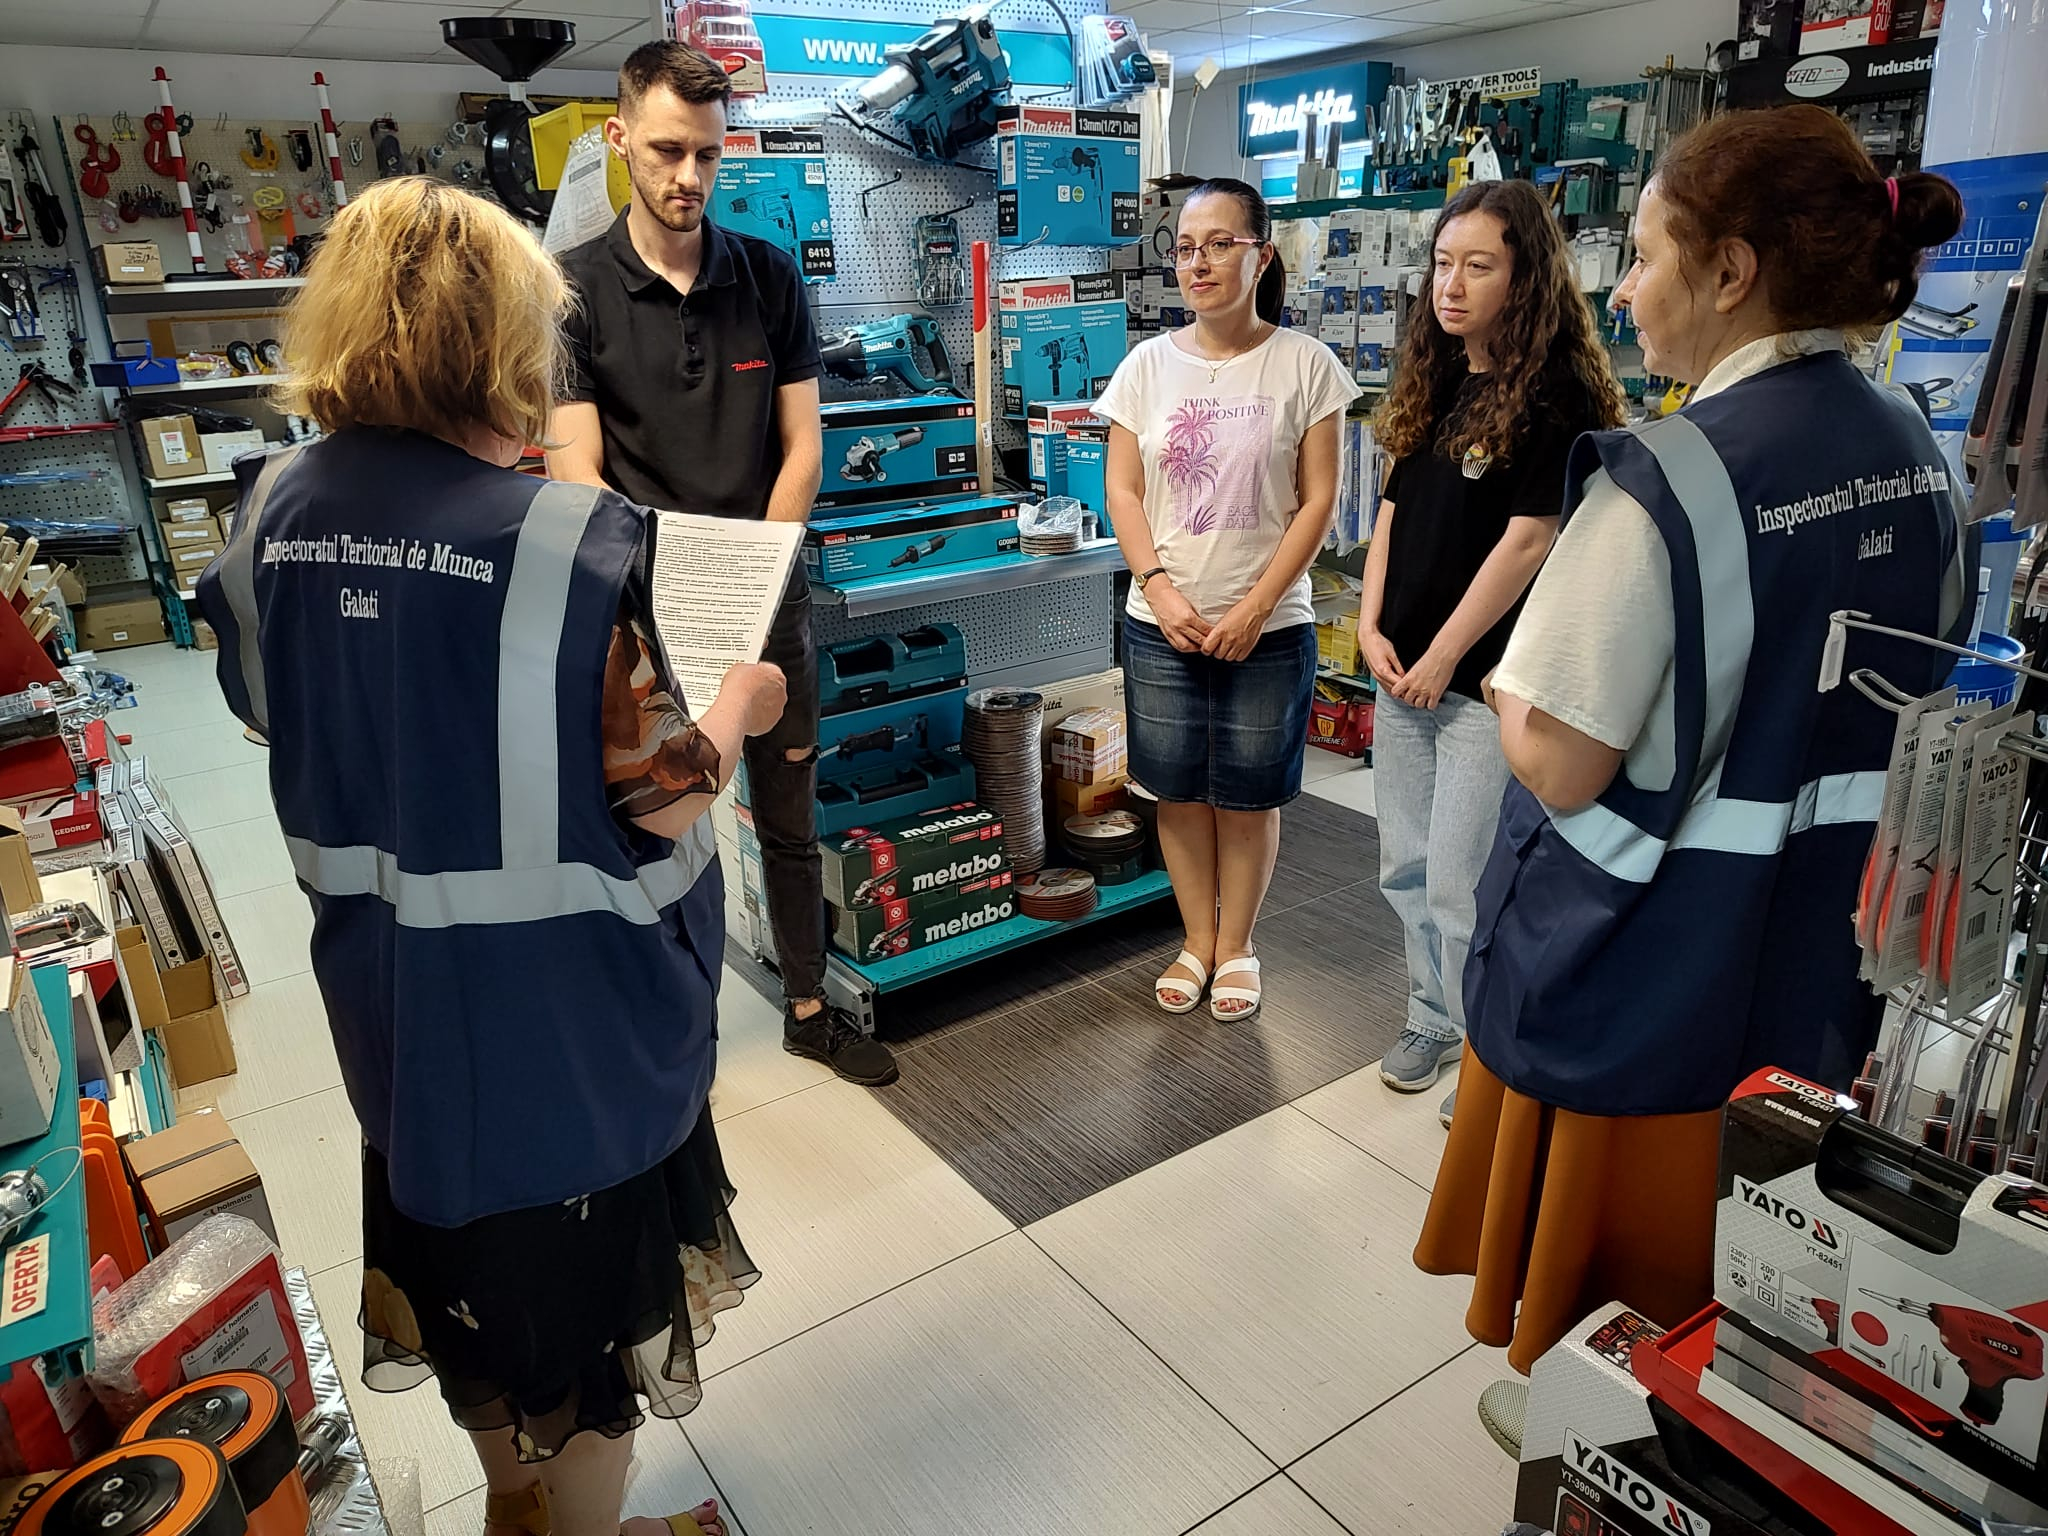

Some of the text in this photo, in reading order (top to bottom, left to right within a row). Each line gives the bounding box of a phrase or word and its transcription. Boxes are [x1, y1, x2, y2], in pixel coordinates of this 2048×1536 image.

[1502, 68, 1538, 84] TOOLS
[1248, 87, 1357, 137] Makita
[1020, 118, 1071, 135] Makita
[1123, 119, 1138, 135] Drill
[806, 141, 822, 151] Drill
[1113, 198, 1138, 208] DP4003
[807, 247, 831, 258] 6413
[1023, 293, 1071, 309] Makita
[1077, 289, 1116, 302] Hammer Drill
[863, 341, 894, 354] Makita
[731, 359, 769, 372] Makita
[1184, 397, 1221, 408] THINK
[1207, 404, 1269, 421] POSITIVE
[1227, 505, 1257, 517] EACH
[1755, 480, 1854, 536] Inspectoratul
[1913, 472, 1929, 494] de
[1225, 517, 1249, 529] DAY
[1858, 525, 1893, 561] Galati
[262, 534, 494, 584] Inspectoratul Teritorial de Munca
[340, 587, 379, 619] Galati
[1320, 720, 1331, 736] GP
[1904, 736, 1920, 756] YAT
[1982, 762, 2009, 785] YATO
[55, 824, 87, 836] GEDORE
[899, 811, 994, 838] metabo
[912, 853, 1002, 892] metabo
[925, 901, 1013, 942] metabo
[1777, 1075, 1818, 1096] YATO
[1764, 1098, 1822, 1128] www.yato.com
[1797, 1094, 1836, 1113] YT-82451
[216, 1193, 253, 1213] holmatro
[1740, 1180, 1806, 1230] YATO
[1730, 1253, 1747, 1268] 50Hz
[1804, 1243, 1843, 1272] YT-82451
[10, 1240, 41, 1315] OFERTA
[1759, 1262, 1776, 1277] 200
[1762, 1272, 1772, 1283] W
[228, 1300, 259, 1329] holmatro
[1986, 1338, 2008, 1351] YATO
[1961, 1423, 2036, 1472] www.yato.com
[1573, 1438, 1656, 1512] YATO
[1560, 1467, 1601, 1503] YT-39009
